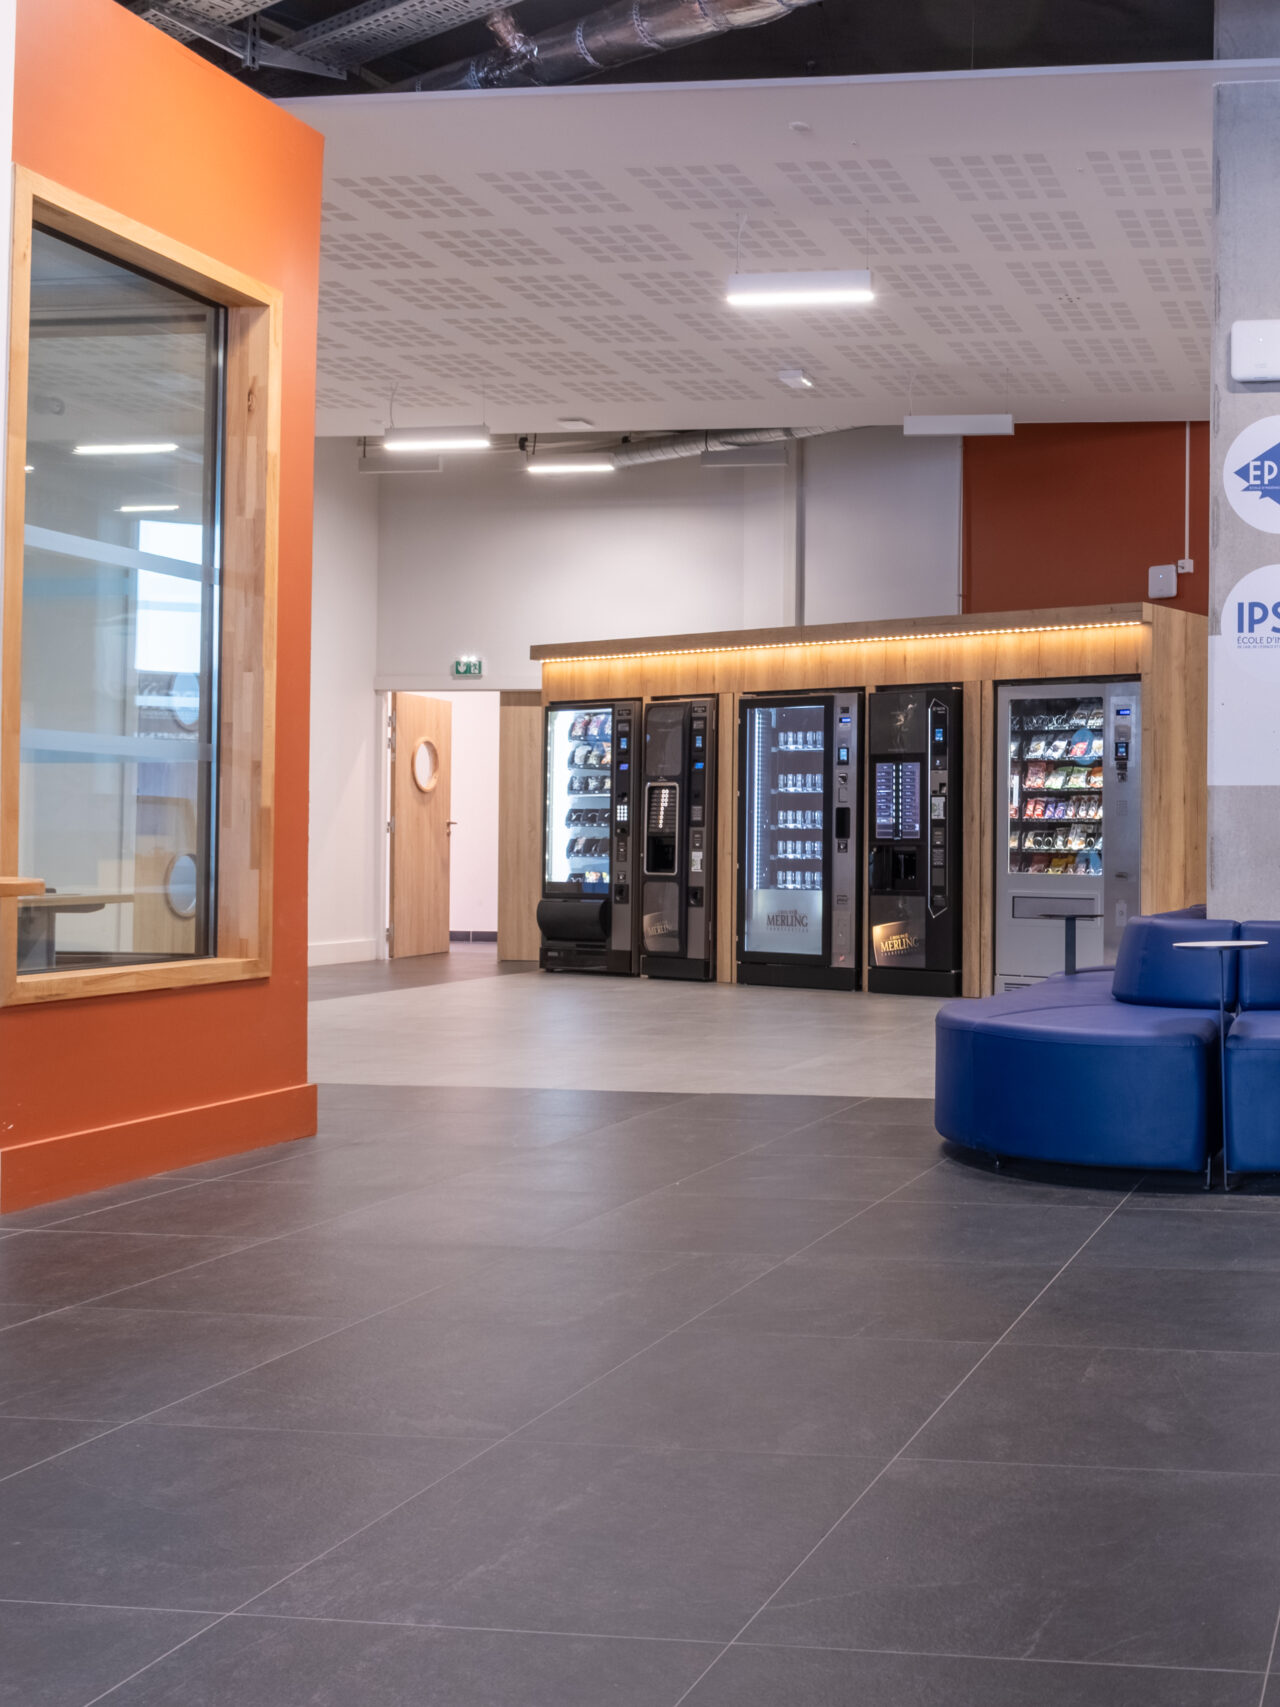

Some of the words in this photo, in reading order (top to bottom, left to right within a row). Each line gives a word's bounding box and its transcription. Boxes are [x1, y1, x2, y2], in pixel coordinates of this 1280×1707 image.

[1237, 635, 1264, 645] ÉCOLE
[767, 914, 808, 927] MERLING
[880, 936, 920, 952] MERLING
